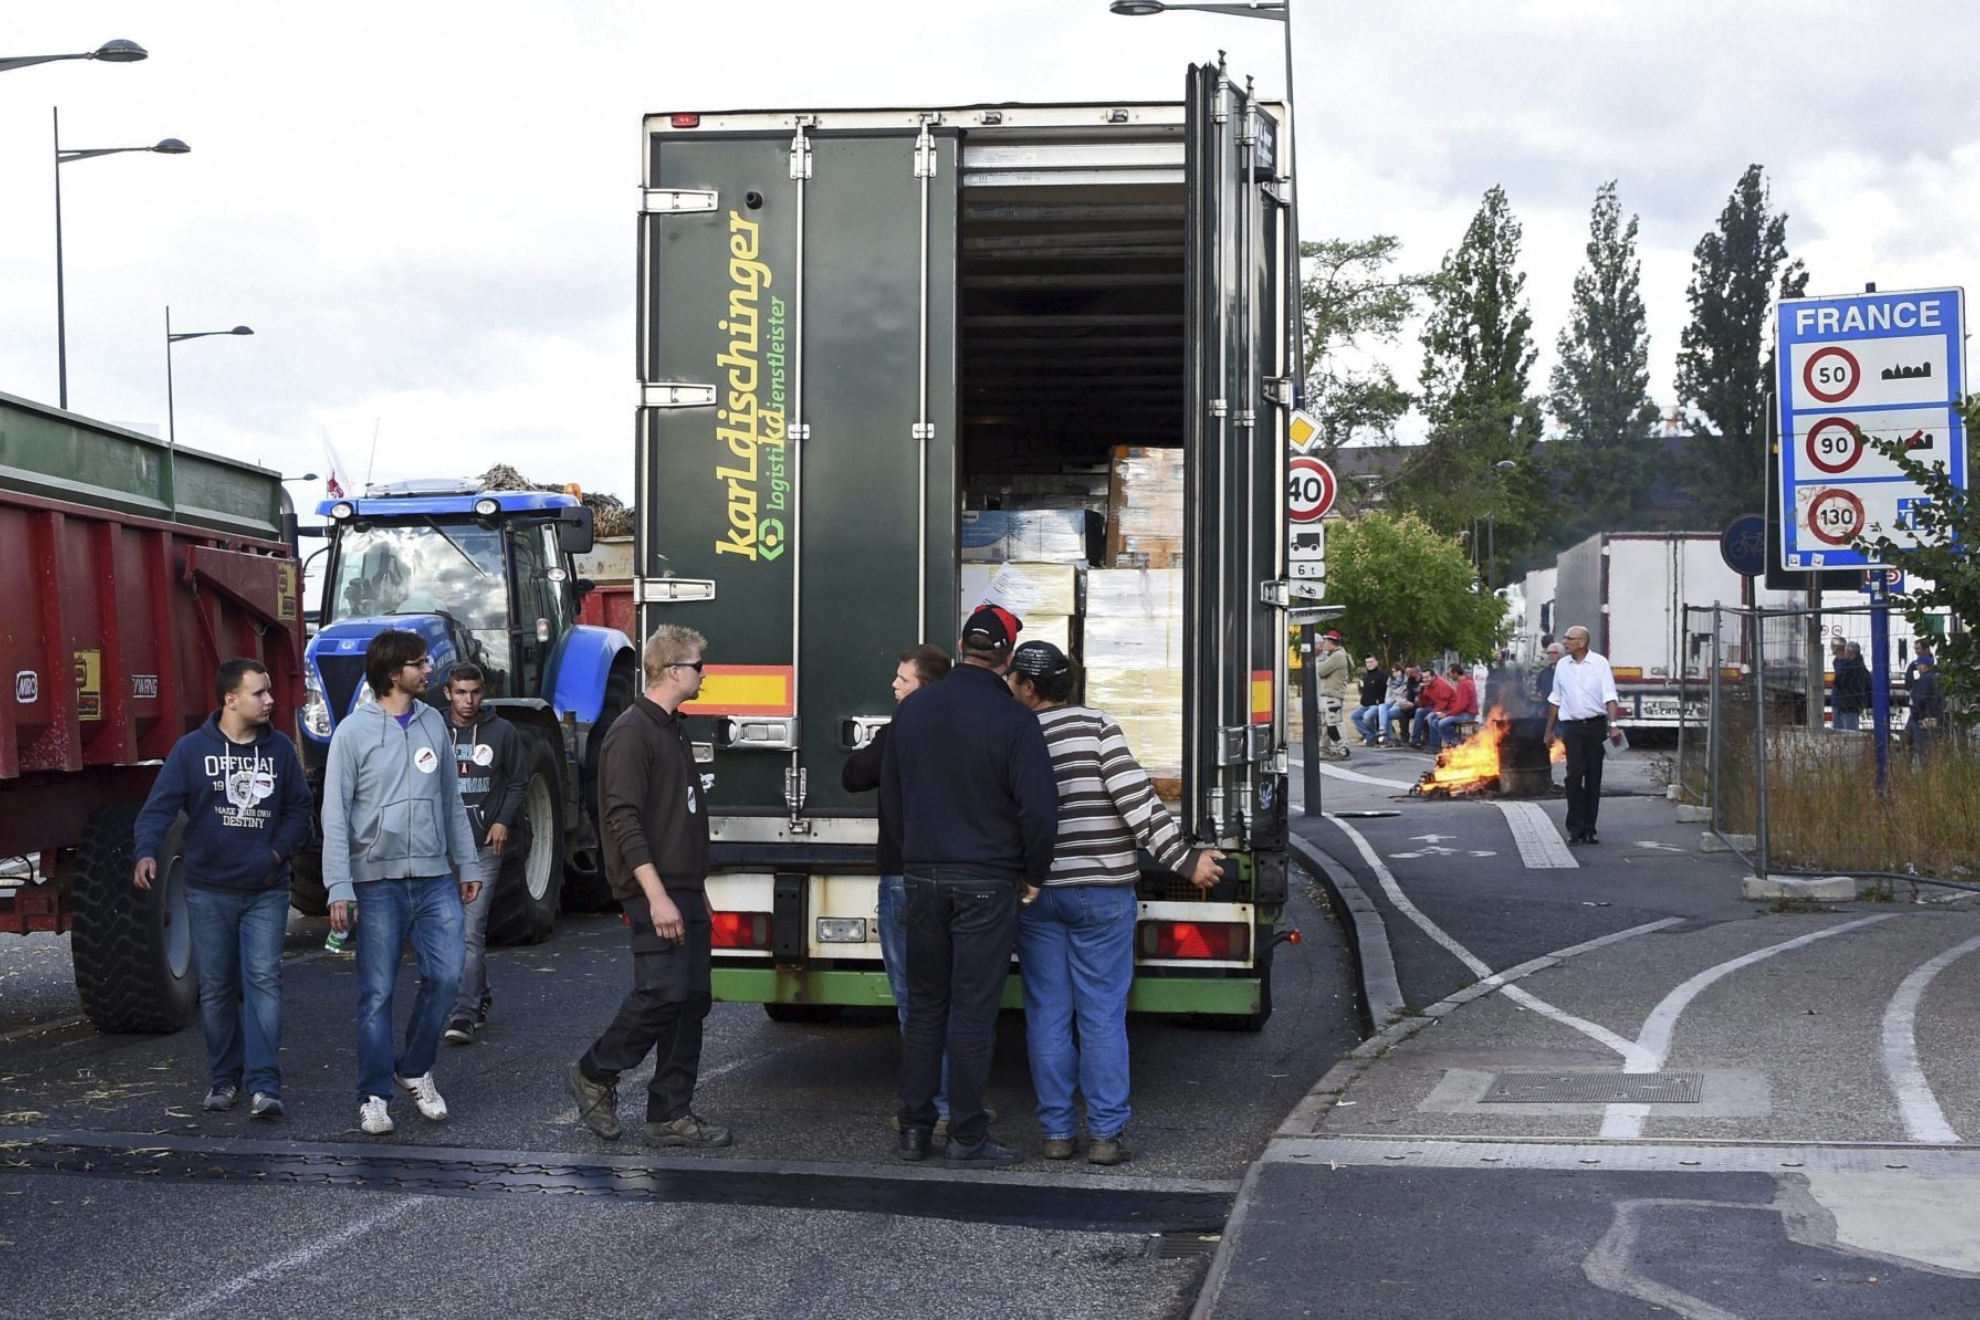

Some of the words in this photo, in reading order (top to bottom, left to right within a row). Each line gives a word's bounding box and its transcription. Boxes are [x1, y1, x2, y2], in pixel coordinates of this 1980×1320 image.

[1796, 300, 1942, 336] FRANCE
[1819, 366, 1846, 384] 50
[1821, 437, 1848, 454] 90
[1289, 477, 1322, 503] 40
[1820, 508, 1853, 526] 130
[1298, 564, 1305, 576] 6
[204, 755, 278, 779] OFFICAL
[222, 815, 265, 829] DESTINY
